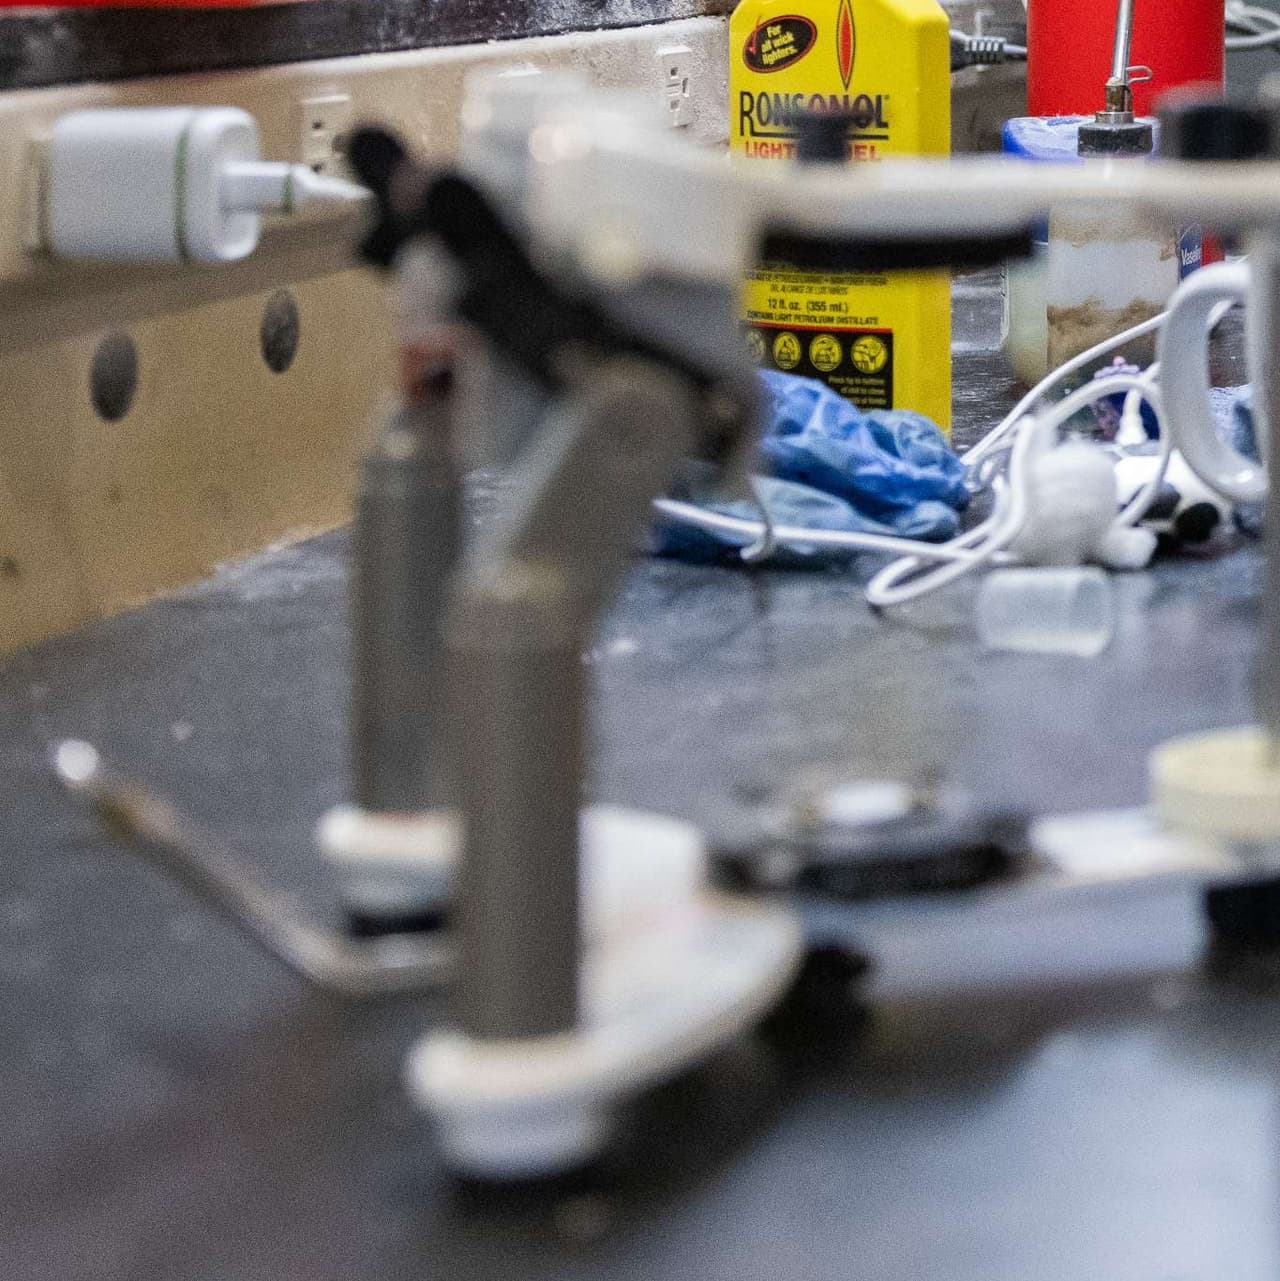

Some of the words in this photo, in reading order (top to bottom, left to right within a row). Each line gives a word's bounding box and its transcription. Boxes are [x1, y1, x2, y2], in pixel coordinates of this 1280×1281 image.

[766, 24, 781, 38] For
[761, 39, 772, 53] all
[772, 31, 795, 49] wick
[745, 140, 797, 160] LIGHT
[768, 298, 777, 309] 12
[778, 299, 787, 310] fl.
[788, 302, 801, 311] oz.
[806, 300, 827, 314] (355
